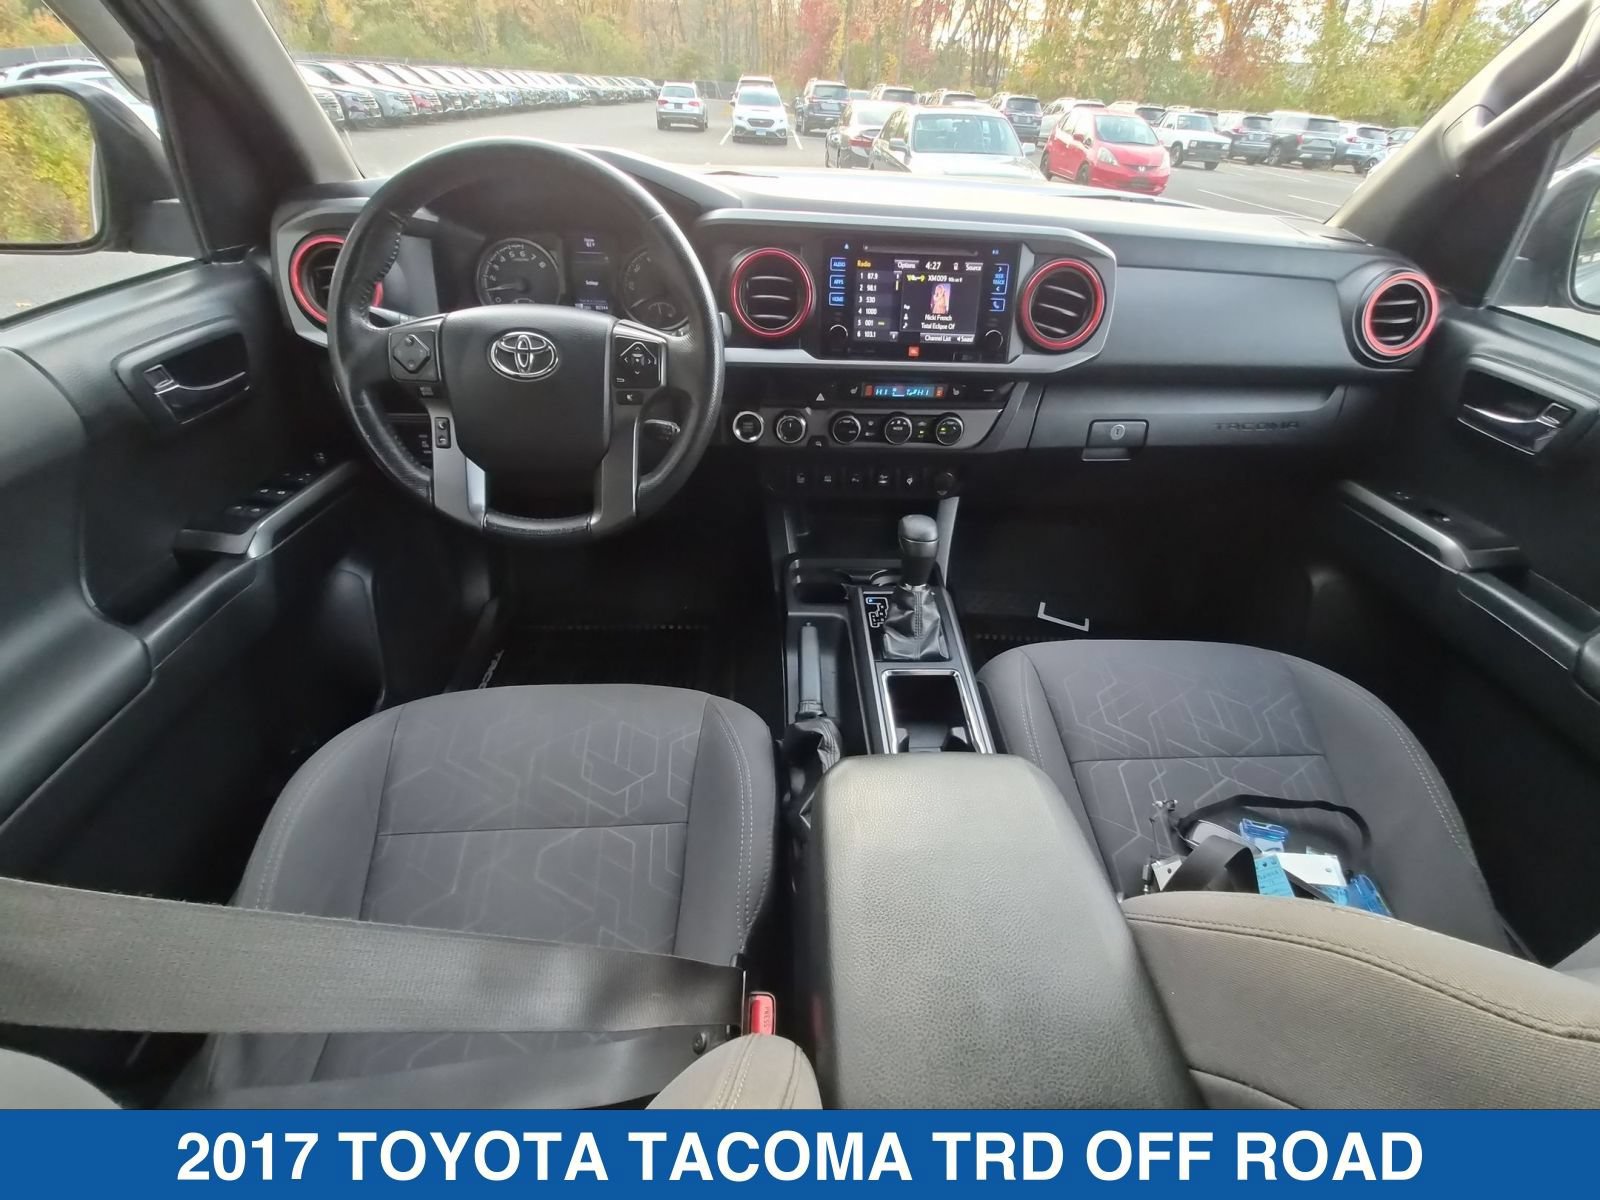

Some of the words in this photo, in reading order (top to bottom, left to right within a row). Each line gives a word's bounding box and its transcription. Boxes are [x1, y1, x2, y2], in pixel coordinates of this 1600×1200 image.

[857, 259, 871, 267] Radio
[897, 262, 916, 270] Options
[925, 261, 942, 270] 4:27
[1216, 422, 1299, 432] TACOMA
